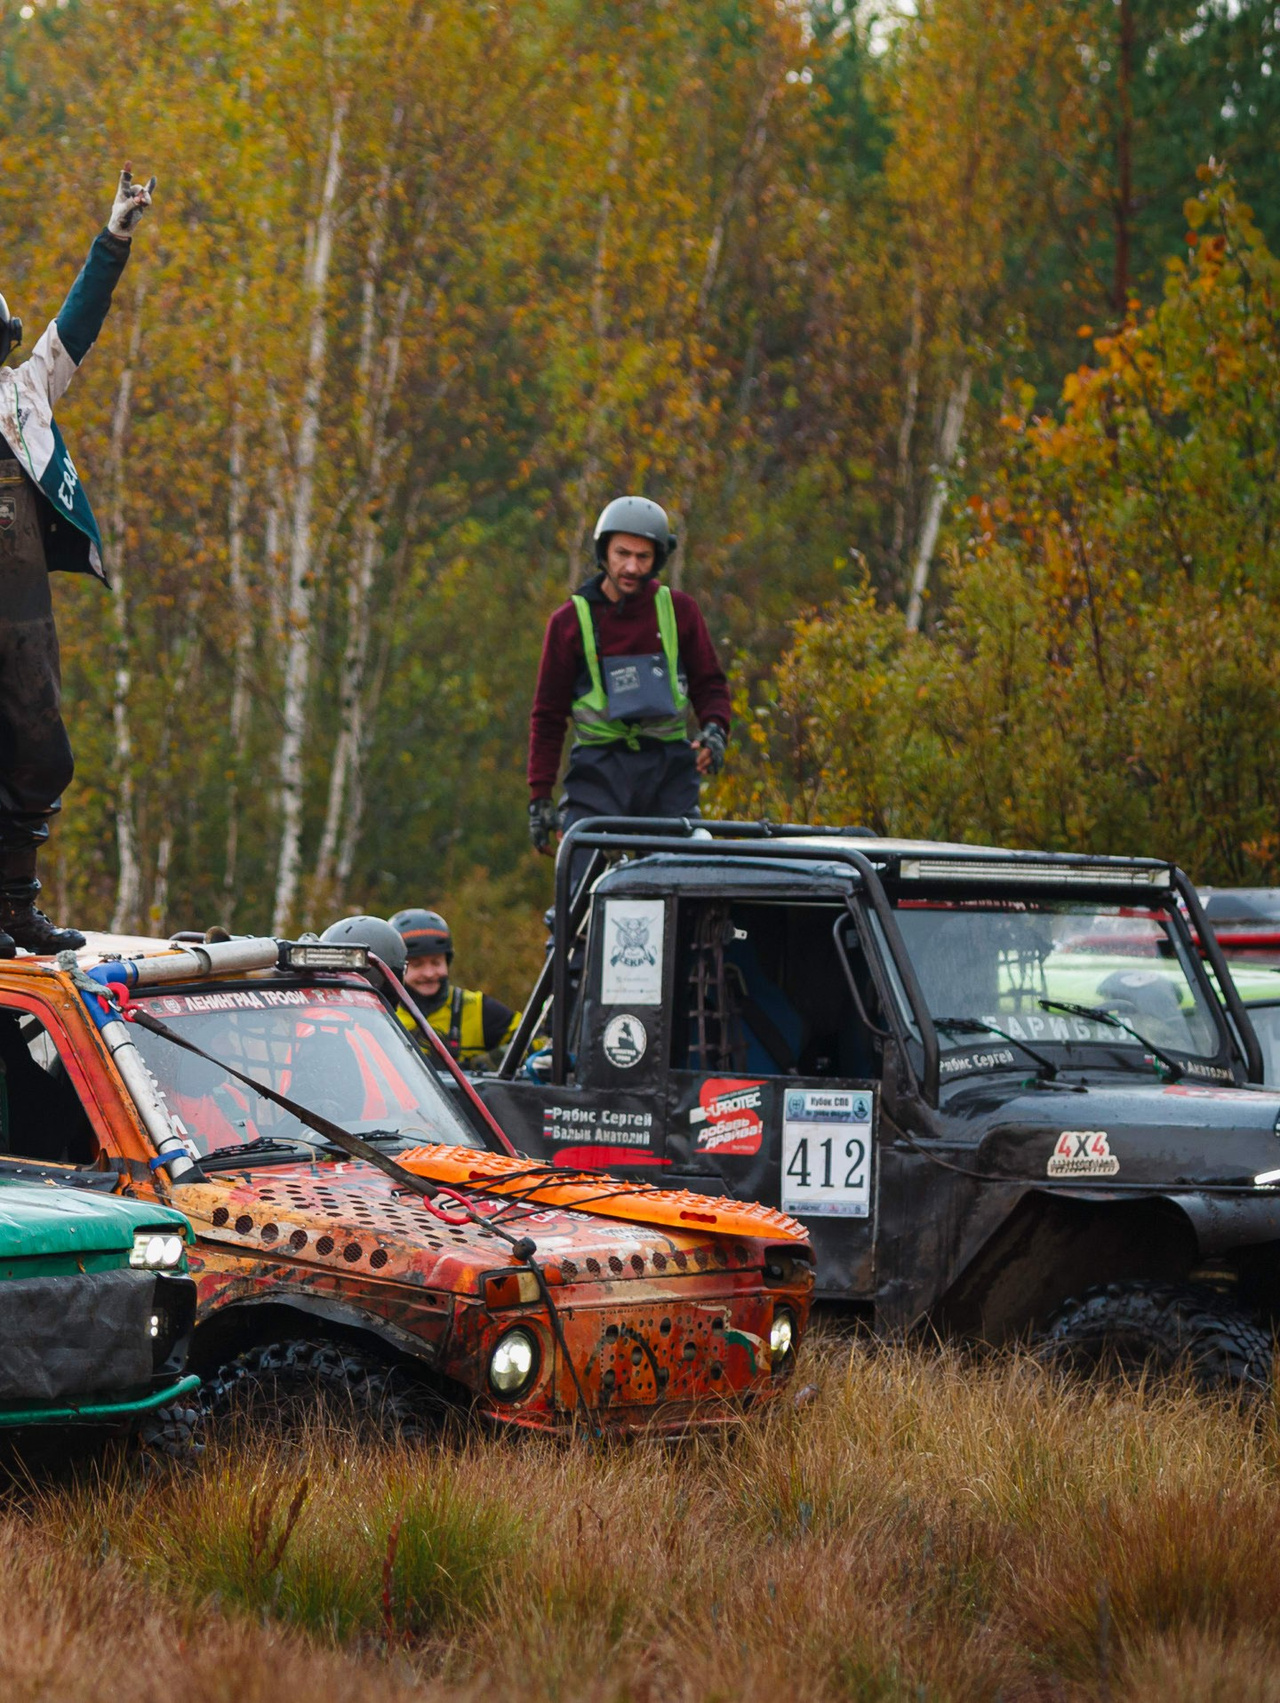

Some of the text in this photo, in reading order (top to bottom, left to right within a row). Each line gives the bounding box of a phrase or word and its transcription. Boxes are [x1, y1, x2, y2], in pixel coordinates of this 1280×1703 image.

[185, 992, 265, 1012] ЛЕНИНГРАД
[259, 990, 310, 1008] ТРОФИ
[552, 1106, 652, 1127] Рябис Сергей
[553, 1125, 651, 1145] Балык Анатолий
[786, 1137, 866, 1188] 412
